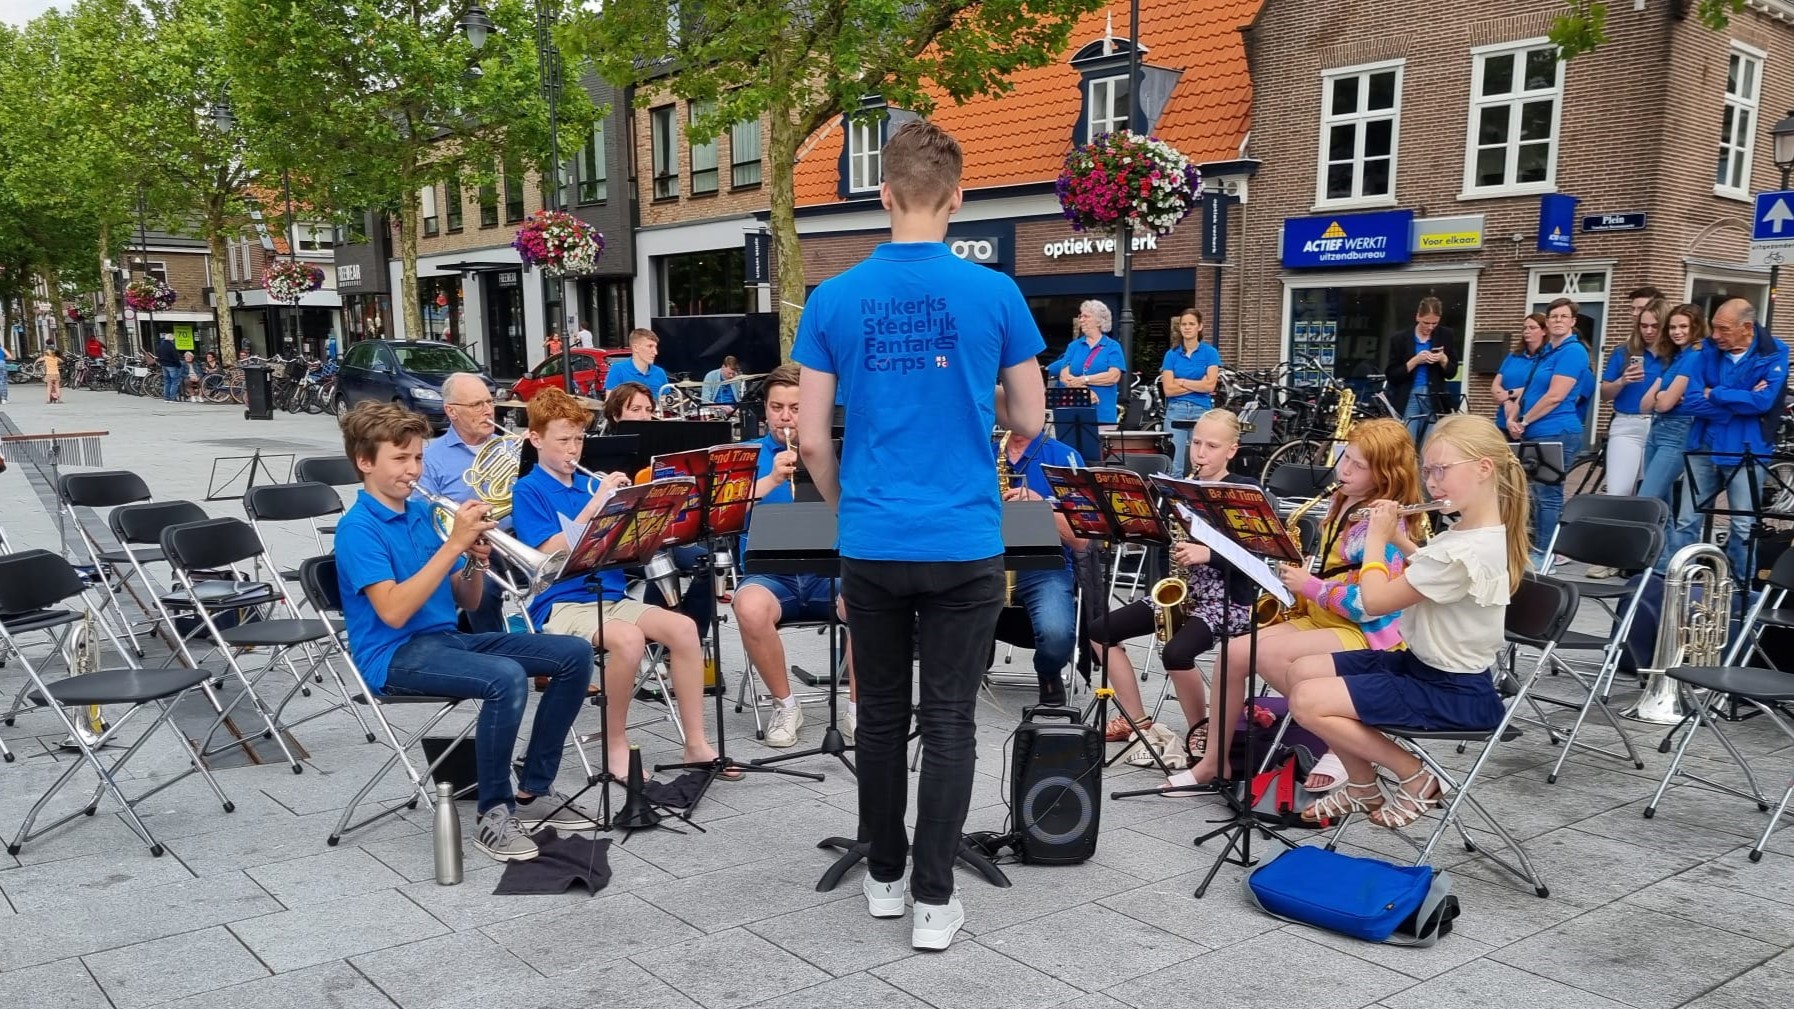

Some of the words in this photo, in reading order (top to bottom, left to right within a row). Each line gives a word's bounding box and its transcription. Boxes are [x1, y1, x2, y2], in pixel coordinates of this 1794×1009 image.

[1602, 215, 1625, 224] Plein
[1044, 237, 1093, 259] optiek
[1096, 233, 1157, 252] veerk
[1303, 238, 1345, 252] ACTIEF
[1319, 250, 1386, 261] uitzendbureau
[337, 264, 361, 281] FREEWEAR
[860, 294, 947, 320] Nijkerks
[863, 312, 958, 336] Stedelijk
[863, 354, 926, 375] Corps
[1235, 490, 1263, 502] Time
